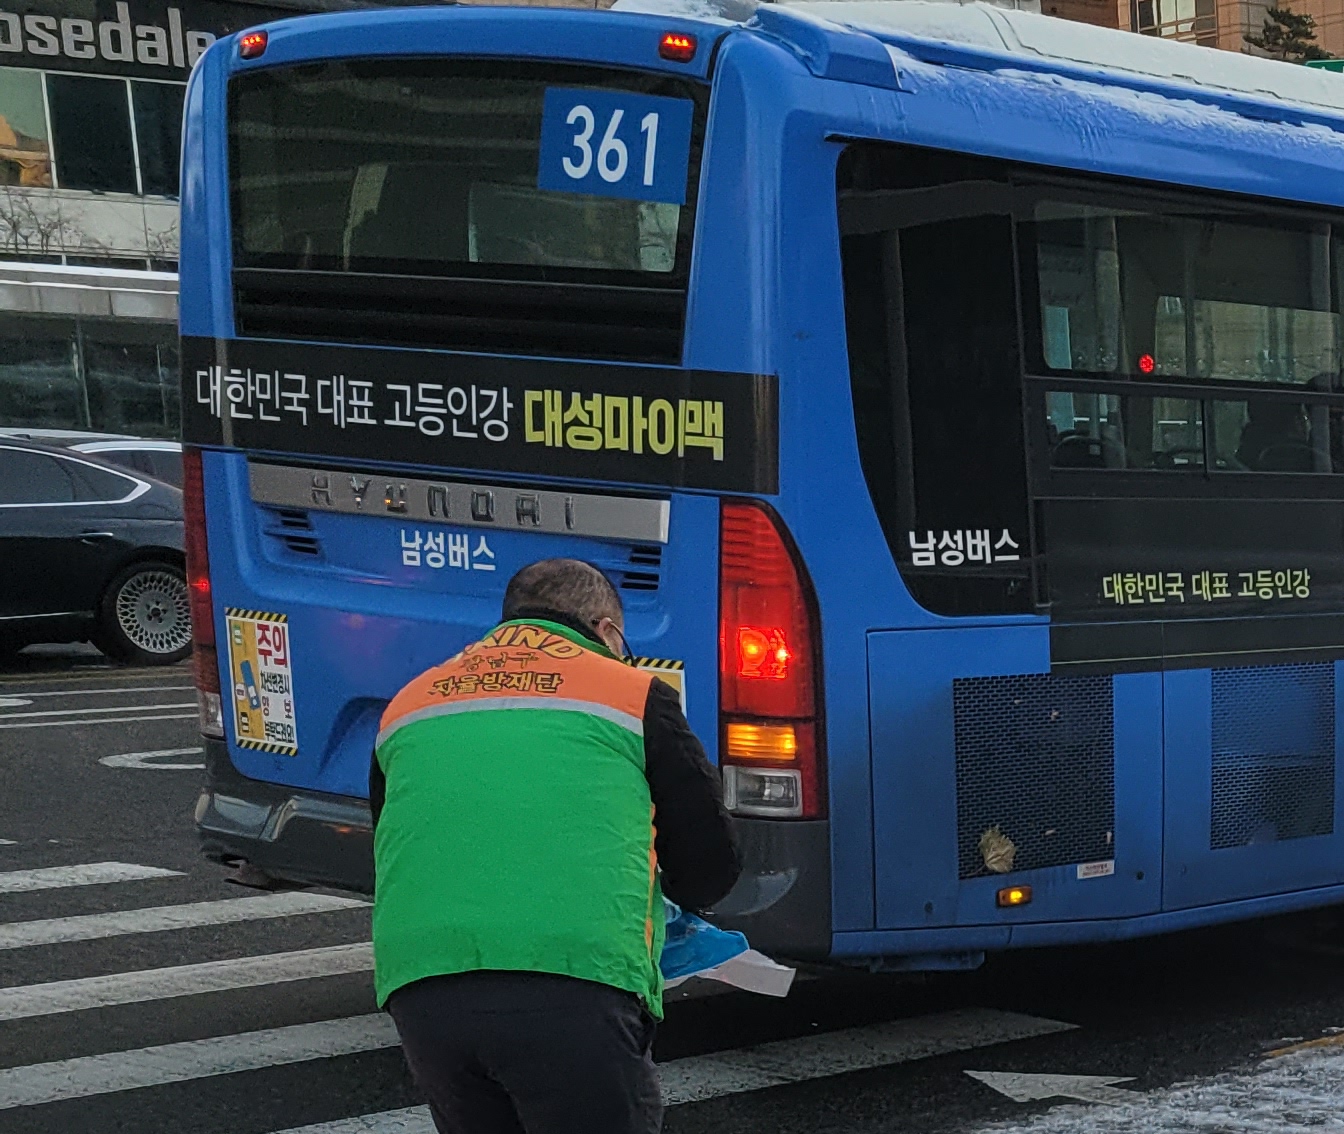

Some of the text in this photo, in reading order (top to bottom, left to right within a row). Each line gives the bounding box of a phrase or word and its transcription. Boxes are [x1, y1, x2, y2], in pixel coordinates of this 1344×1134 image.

[562, 104, 659, 187] 361
[196, 365, 725, 462] 대한민국 대표 고등인강 대성마이맥
[309, 474, 576, 531] HYUNDAI
[401, 528, 496, 572] 남성버스
[908, 528, 1021, 567] 남성버스
[1103, 571, 1186, 606] 대한민국
[1191, 571, 1232, 602] 대표
[1237, 568, 1312, 600] 고등인강
[256, 622, 289, 669] 주의
